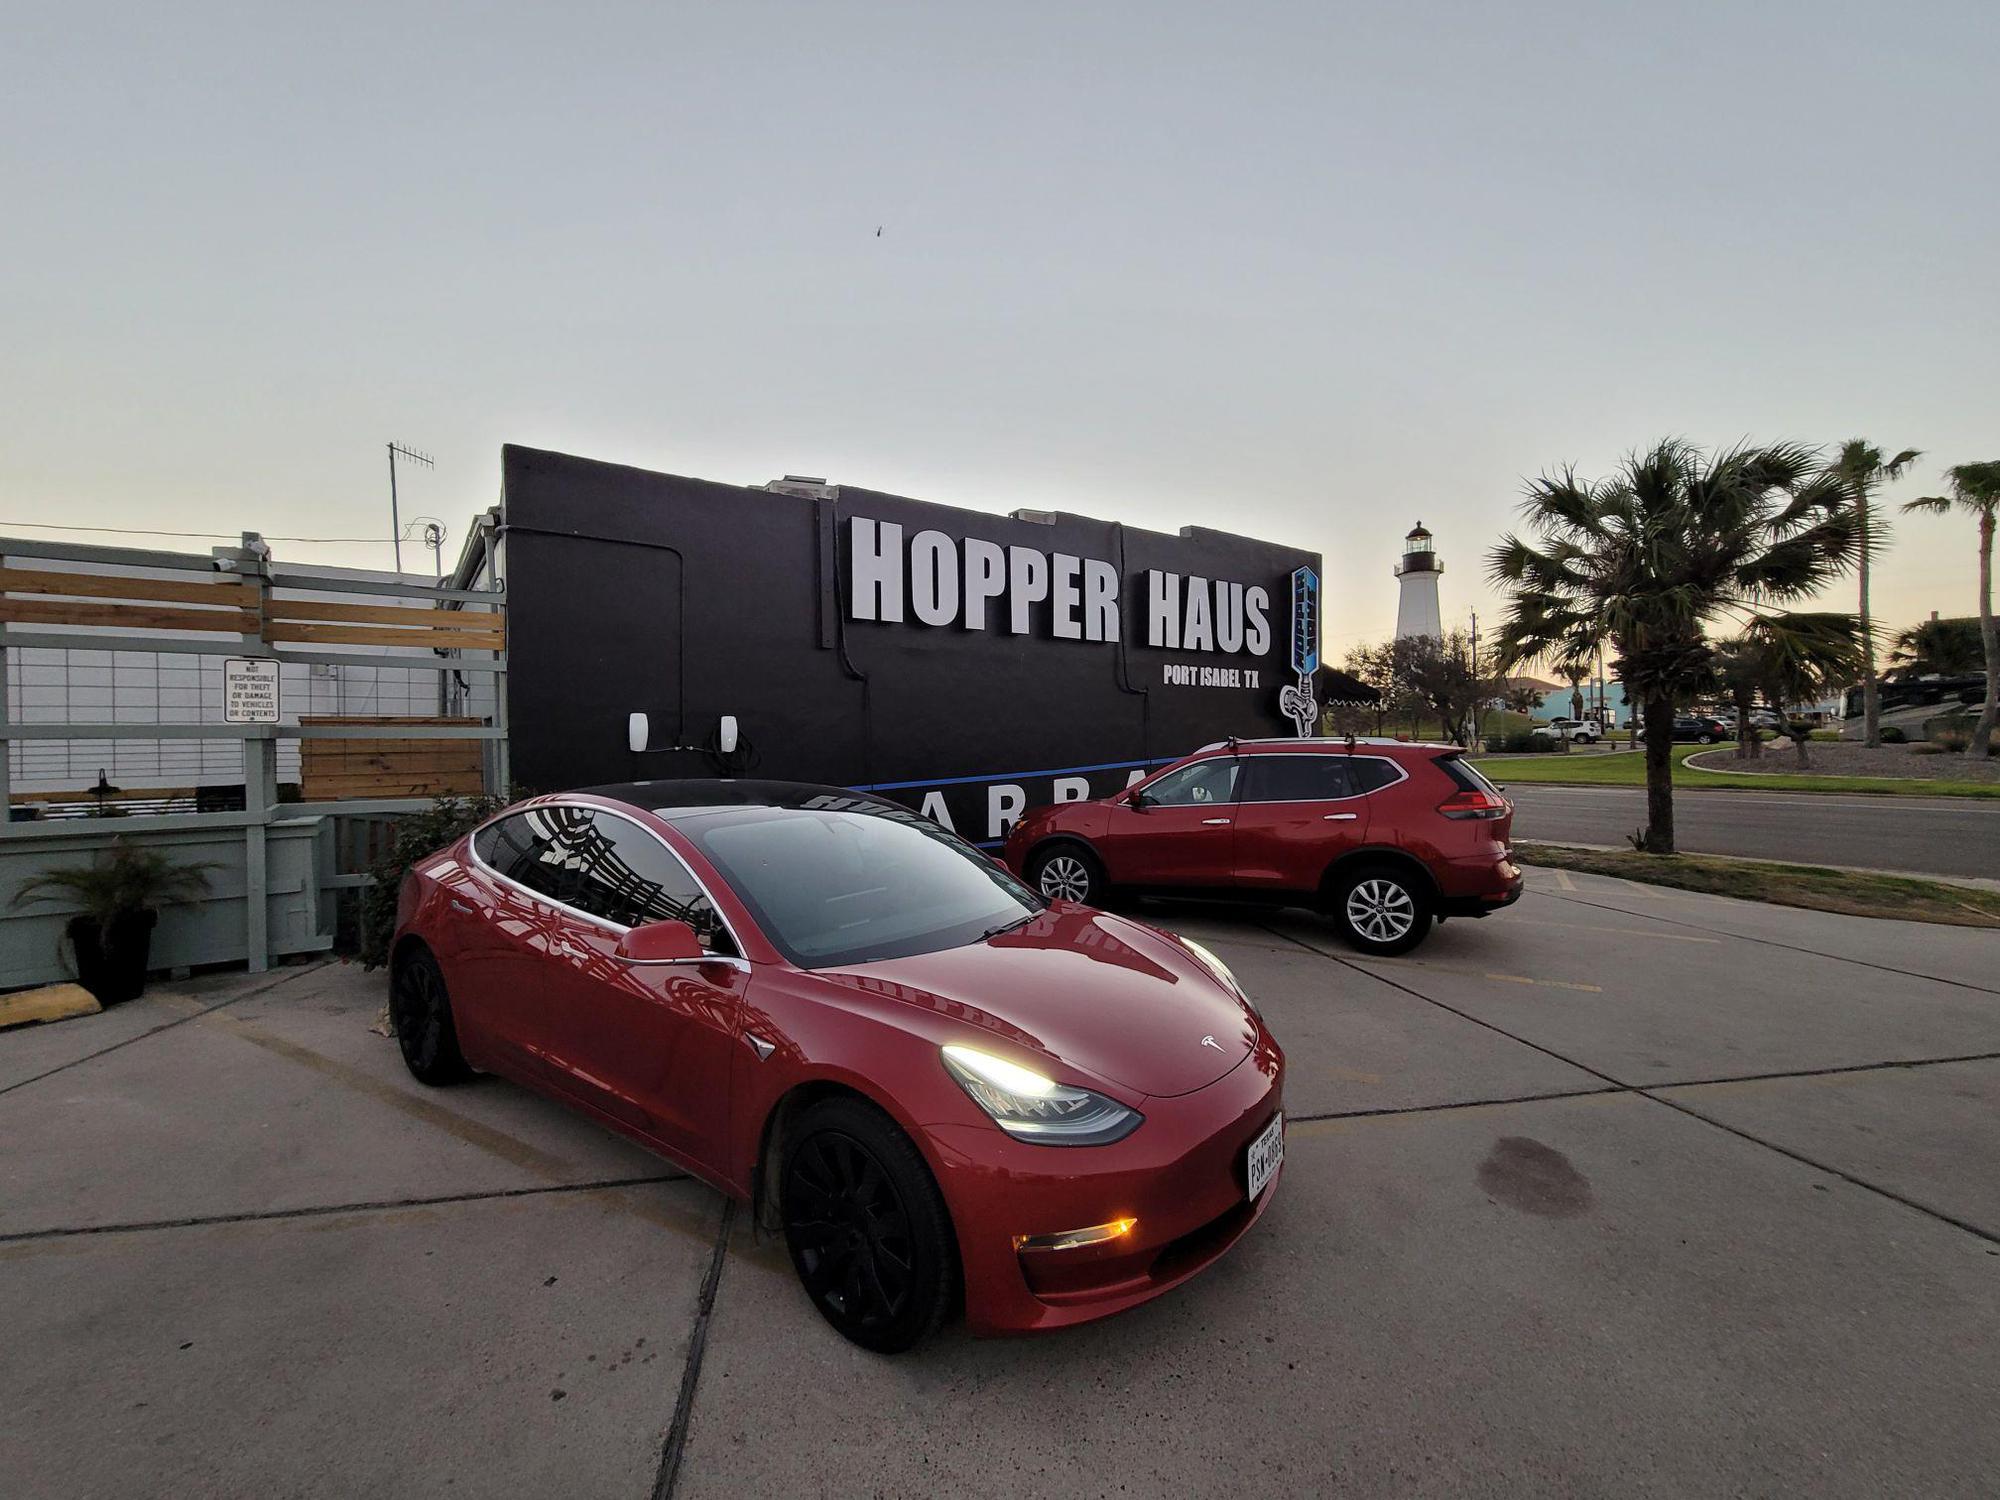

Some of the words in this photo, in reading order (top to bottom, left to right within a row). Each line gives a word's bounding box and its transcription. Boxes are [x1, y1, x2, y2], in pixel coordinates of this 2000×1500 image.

[850, 516, 1121, 643] HOPPER
[1148, 569, 1271, 656] HAUS
[230, 674, 275, 682] RESPONSIBLE
[1163, 664, 1198, 686] PORT
[1200, 667, 1241, 688] ISABEL
[1243, 670, 1259, 689] TX
[1261, 1127, 1275, 1148] TEXAS
